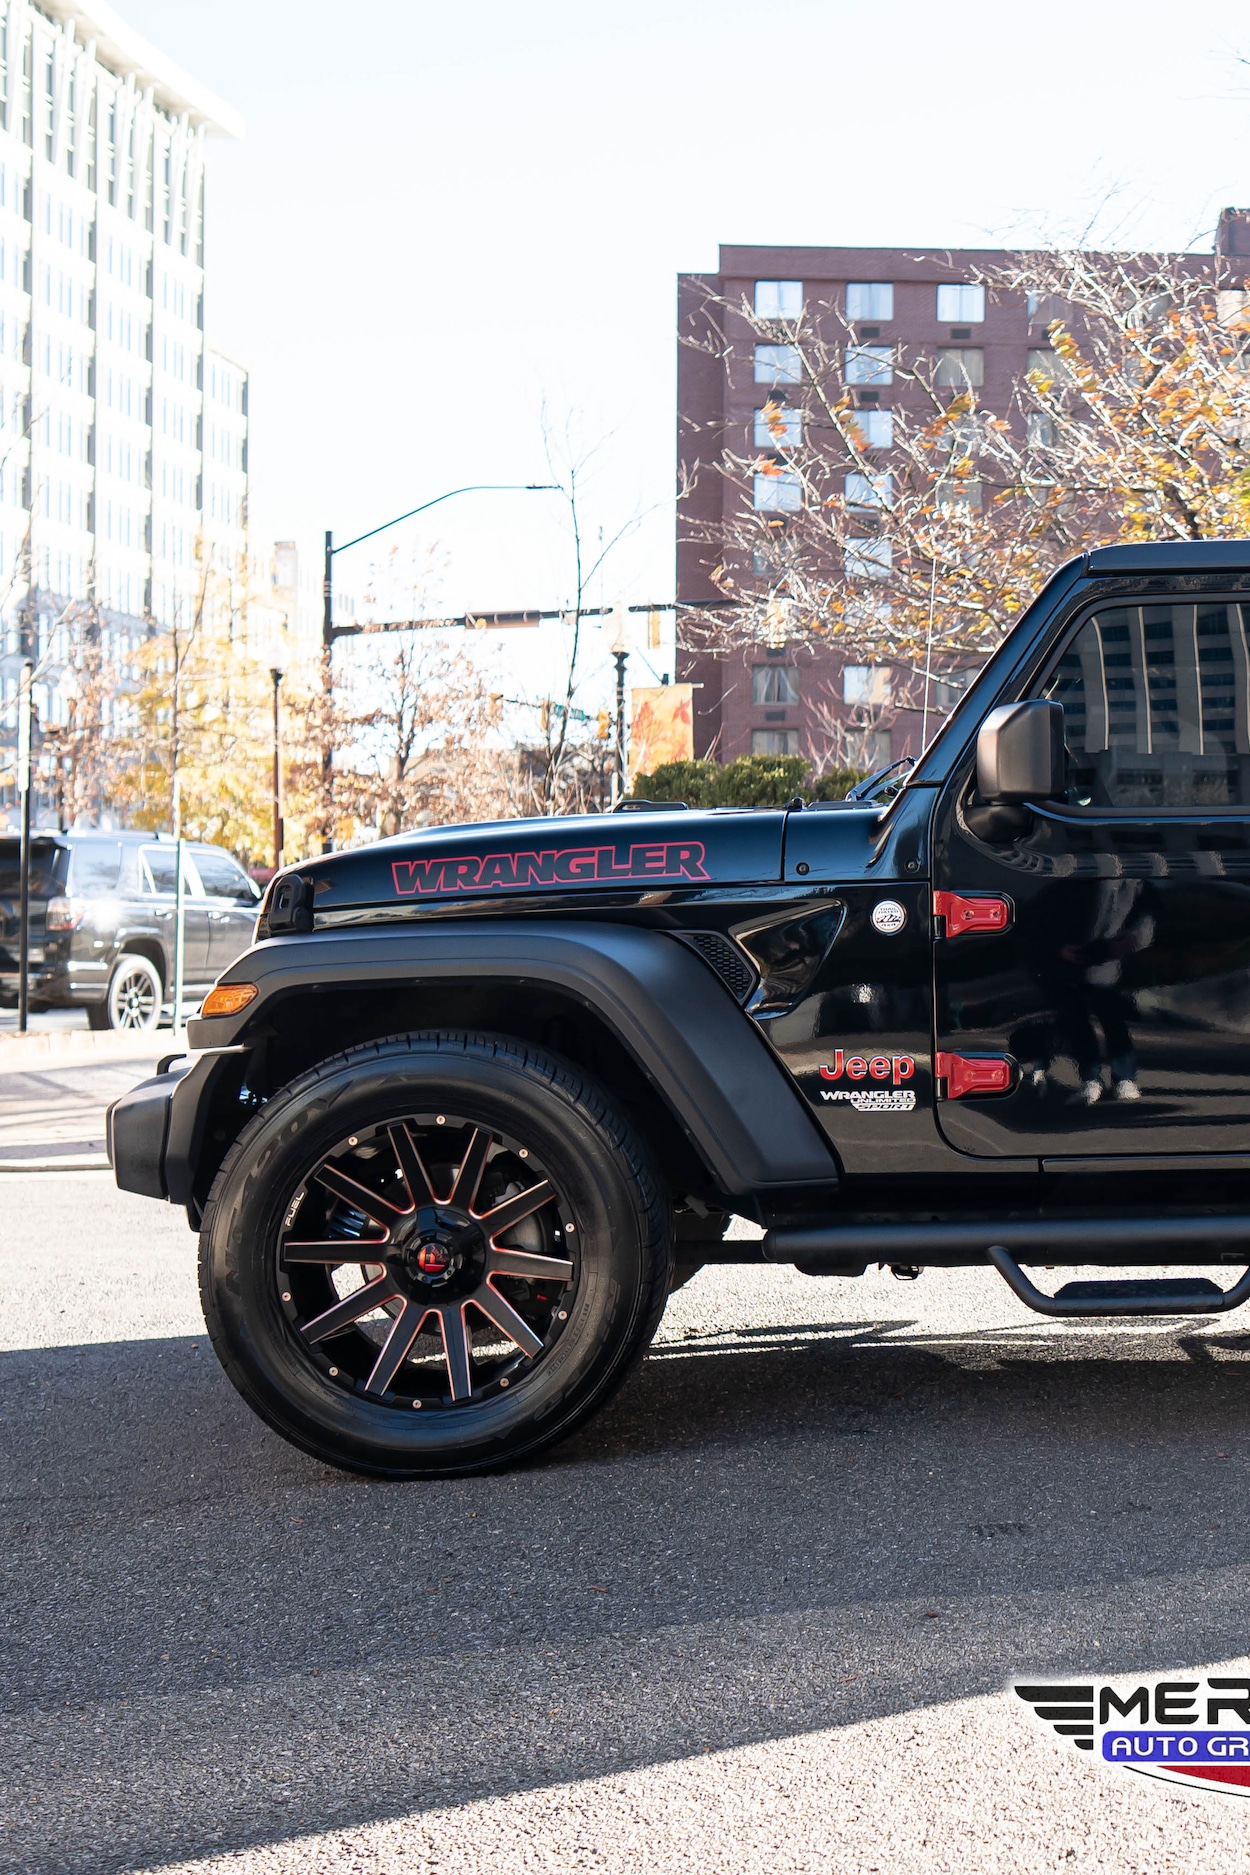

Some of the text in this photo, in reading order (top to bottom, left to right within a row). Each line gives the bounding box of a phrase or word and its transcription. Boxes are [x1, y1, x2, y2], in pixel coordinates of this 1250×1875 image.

[391, 841, 711, 895] WRANGLER
[820, 1049, 915, 1085] Jeep
[820, 1090, 916, 1100] WRANGLER
[285, 1192, 304, 1227] FUEL
